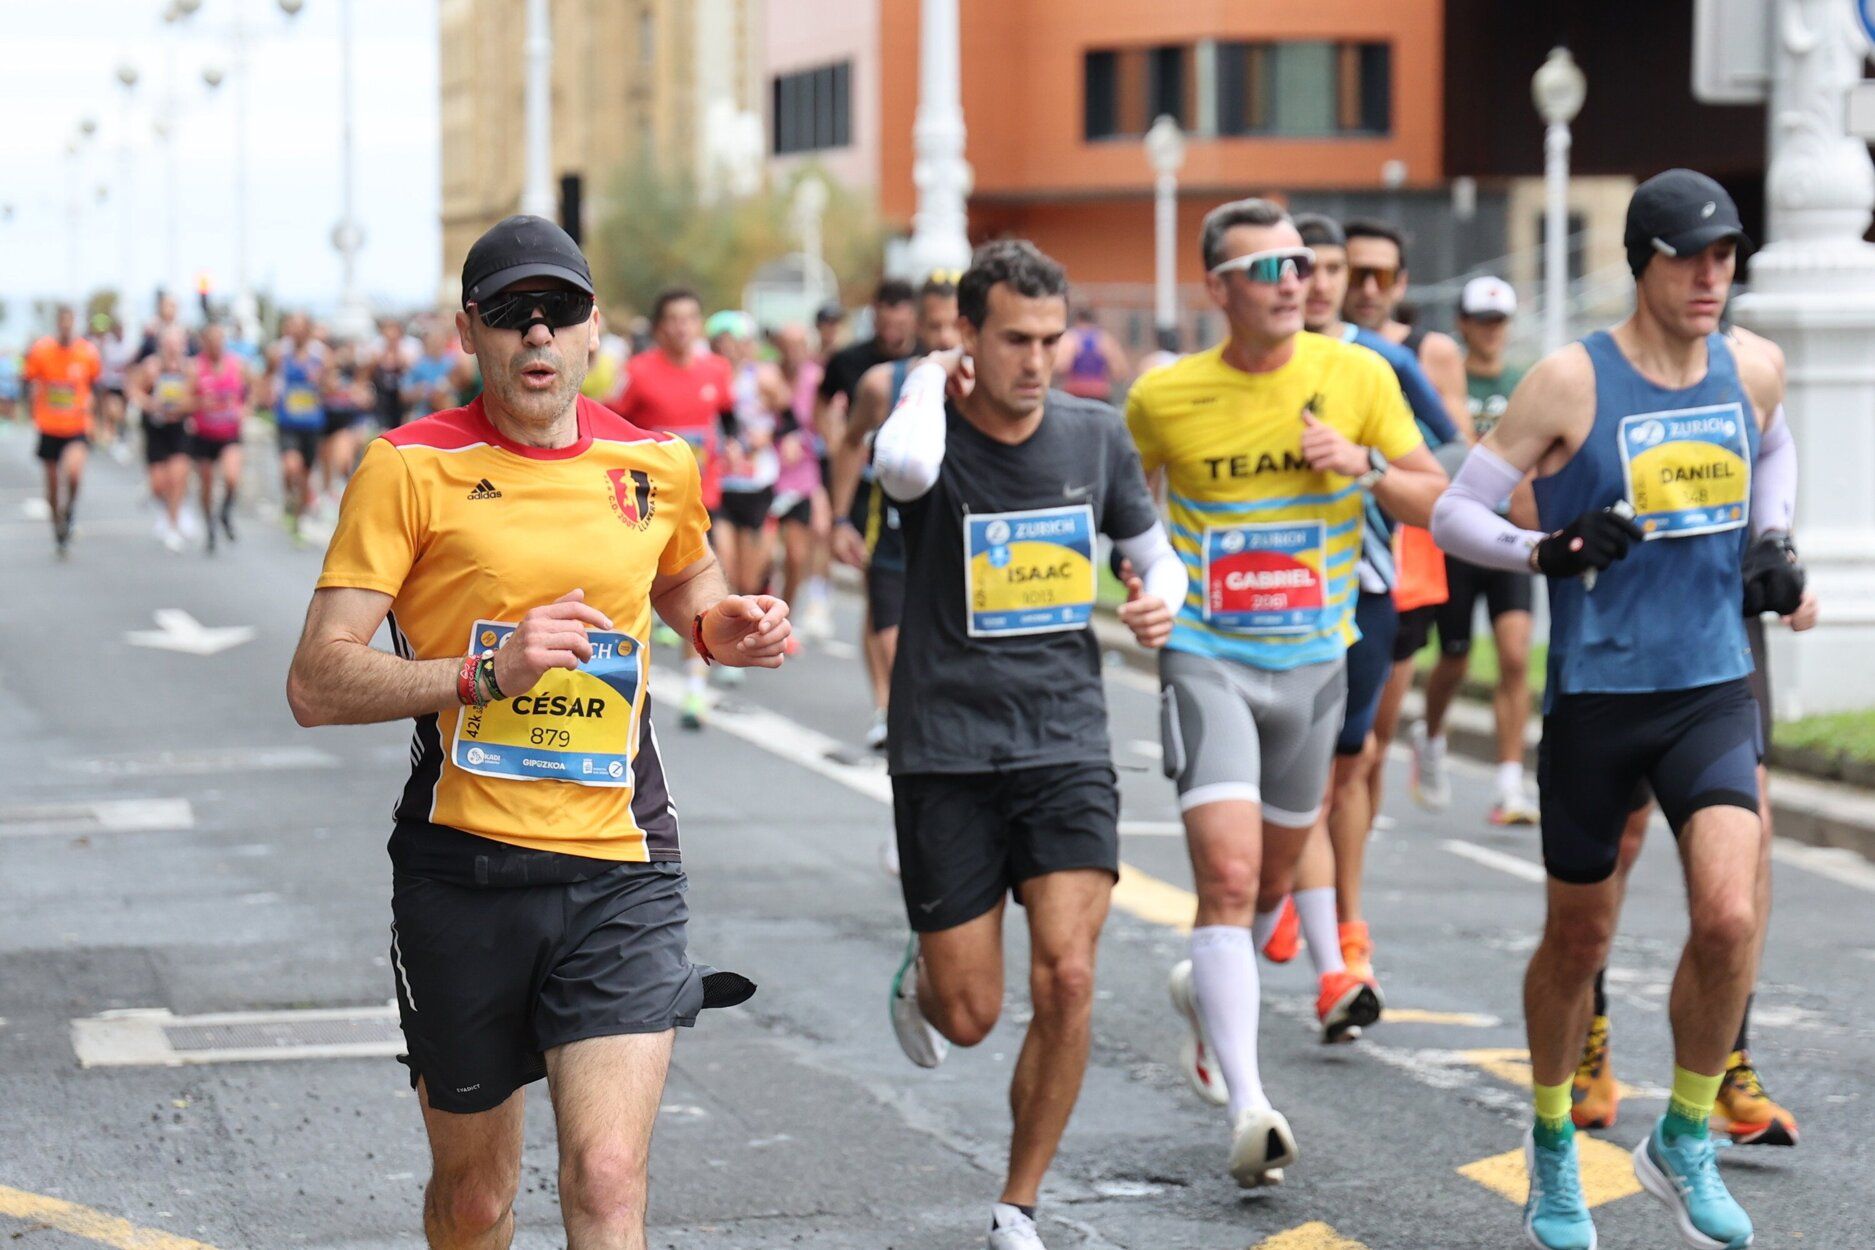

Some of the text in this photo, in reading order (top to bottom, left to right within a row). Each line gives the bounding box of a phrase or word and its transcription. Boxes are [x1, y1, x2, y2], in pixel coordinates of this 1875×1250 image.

[1669, 417, 1724, 436] ZURICH
[1205, 451, 1313, 479] TEAM
[1661, 462, 1734, 484] DANIEL
[467, 490, 502, 501] adidas
[1015, 519, 1075, 538] ZURICH
[1249, 531, 1306, 548] ZURICH
[1007, 562, 1072, 583] ISAAC
[1225, 568, 1316, 591] GABRIEL
[512, 692, 605, 719] CÉSAR
[466, 715, 481, 738] 42k
[530, 727, 570, 747] 879
[523, 758, 565, 770] GIPUZKOA
